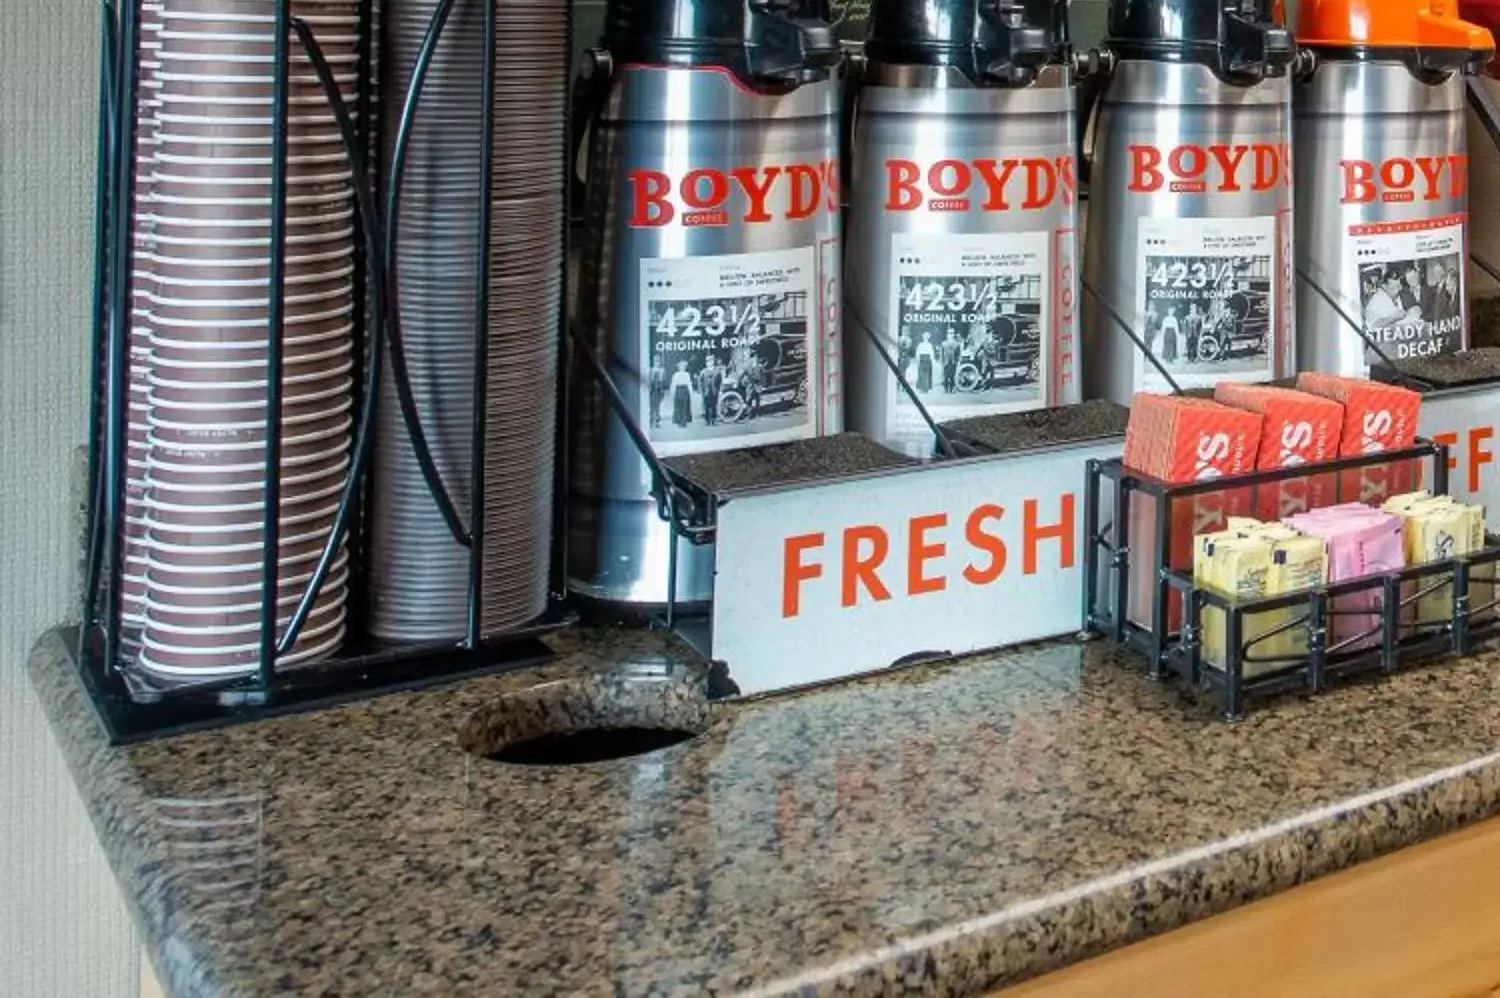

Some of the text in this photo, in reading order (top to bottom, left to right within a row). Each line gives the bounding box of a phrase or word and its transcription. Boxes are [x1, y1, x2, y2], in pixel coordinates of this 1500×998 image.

[1150, 288, 1199, 300] ORIGINAL
[903, 311, 957, 324] ORIGINAL
[1365, 325, 1425, 344] STEADY
[655, 336, 718, 353] ORIGINAL
[1397, 340, 1444, 359] DECAF
[781, 493, 1077, 620] FRESH
